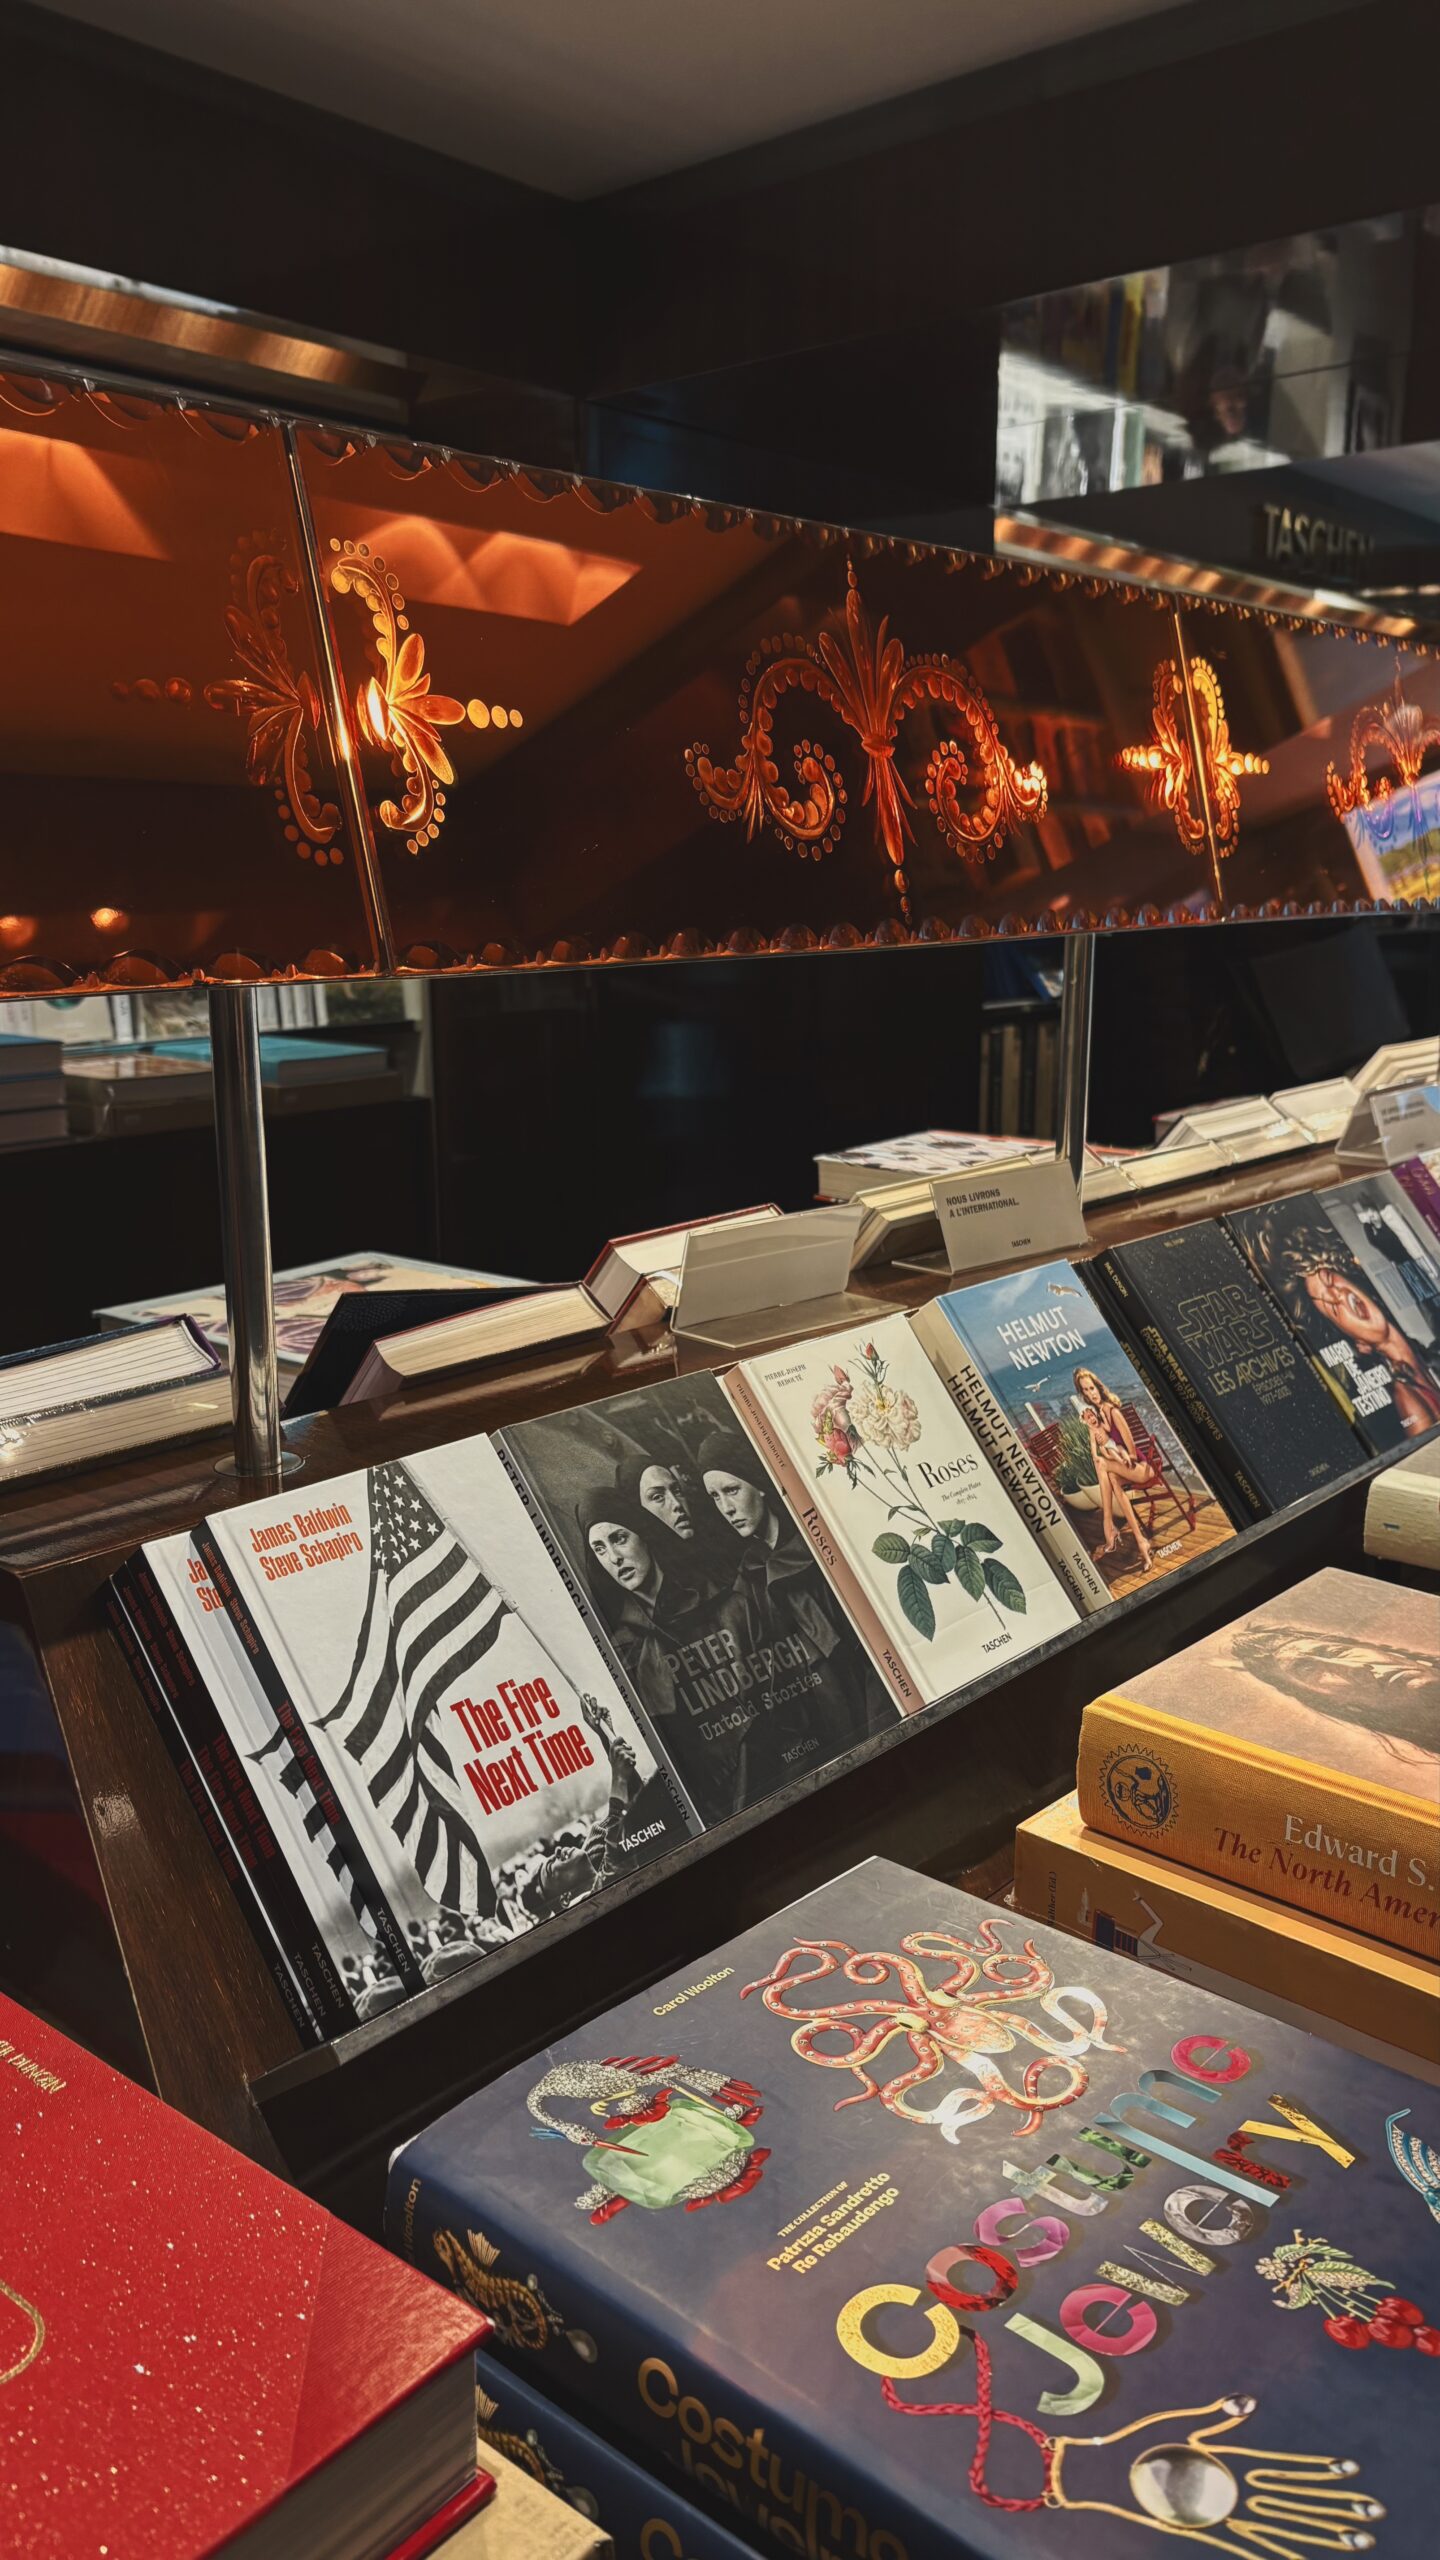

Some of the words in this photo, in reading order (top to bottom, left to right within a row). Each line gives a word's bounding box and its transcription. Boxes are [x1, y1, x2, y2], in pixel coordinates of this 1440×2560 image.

[946, 1195, 967, 1206] NOUS
[969, 1189, 1000, 1202] LIVRONS
[996, 1306, 1066, 1346] HELMUT
[1177, 1285, 1262, 1340] STAR
[1184, 1312, 1275, 1370] WARS
[1007, 1329, 1086, 1371] NEWTON
[1208, 1370, 1237, 1396] LES
[1236, 1345, 1295, 1387] ARCHIVES
[1320, 1340, 1353, 1368] MARIO
[1344, 1358, 1361, 1378] DE
[1146, 1323, 1171, 1356] STAR
[1184, 1383, 1197, 1399] LES
[1192, 1398, 1224, 1442] ARCHIVES
[1352, 1388, 1392, 1417] TESTINO
[1354, 1364, 1392, 1395] JANEIRO
[917, 1453, 978, 1488] Roses
[947, 1375, 999, 1453] HELMUT
[993, 1450, 1047, 1534] NEWTON
[1056, 1558, 1085, 1602] TASCHEN
[960, 1365, 1011, 1442] HELMUT
[1007, 1440, 1061, 1526] NEWTON
[1071, 1552, 1100, 1595] TASCHEN
[1232, 1470, 1263, 1510] TASCHEN
[250, 1521, 297, 1553] James
[293, 1503, 352, 1538] Baldwin
[259, 1551, 304, 1581] Steve
[299, 1531, 363, 1569] Schapiro
[1156, 1541, 1182, 1559] TASCHEN
[802, 1506, 837, 1567] Roses
[881, 1648, 912, 1698] TASCHEN
[497, 1448, 532, 1507] PETER
[656, 1763, 690, 1821] TASCHEN
[666, 1628, 737, 1682] PETER
[981, 1632, 1012, 1654] TASCHEN
[678, 1633, 811, 1718] LINDBERGH
[450, 1694, 507, 1754] The
[497, 1675, 561, 1738] Fire
[699, 1697, 760, 1742] Untold
[761, 1671, 823, 1711] Stories
[202, 1542, 217, 1567] James
[214, 1566, 232, 1596] Baldwin
[230, 1599, 244, 1620] Steve
[240, 1620, 260, 1654] Schapiro
[275, 1701, 296, 1729] The
[287, 1726, 310, 1757] Fire
[301, 1755, 327, 1792] Next
[317, 1789, 343, 1826] Time
[374, 1907, 413, 1973] TASCHEN
[462, 1750, 541, 1817] Next
[527, 1720, 596, 1791] Time
[781, 1736, 820, 1764] TASCHEN
[618, 1819, 666, 1854] TASCHEN
[1215, 1827, 1262, 1863] The
[1269, 1847, 1352, 1897] North
[1285, 1814, 1398, 1878] Edward
[1407, 1858, 1435, 1892] S.
[195, 1745, 216, 1773] The
[236, 1832, 261, 1868] Time
[291, 1951, 330, 2016] TASCHEN
[211, 1733, 232, 1761] The
[224, 1759, 246, 1791] Fire
[237, 1788, 262, 1823] Next
[252, 1822, 278, 1859] Time
[307, 1942, 348, 2009] TASCHEN
[269, 1962, 309, 2028] TASCHEN
[652, 1990, 690, 2017] Carol
[684, 1967, 735, 1998] Woolton
[402, 2177, 422, 2249] Woolton
[766, 2223, 828, 2271] Patrizia
[820, 2172, 891, 2226] Sandretto
[777, 2220, 798, 2238] THE
[793, 2192, 839, 2226] COLLECTION
[834, 2180, 849, 2196] OF
[791, 2252, 818, 2274] Re
[811, 2186, 899, 2257] Rebaudengo
[836, 2035, 1262, 2378] Costume
[1004, 2092, 1356, 2415] Jewelry
